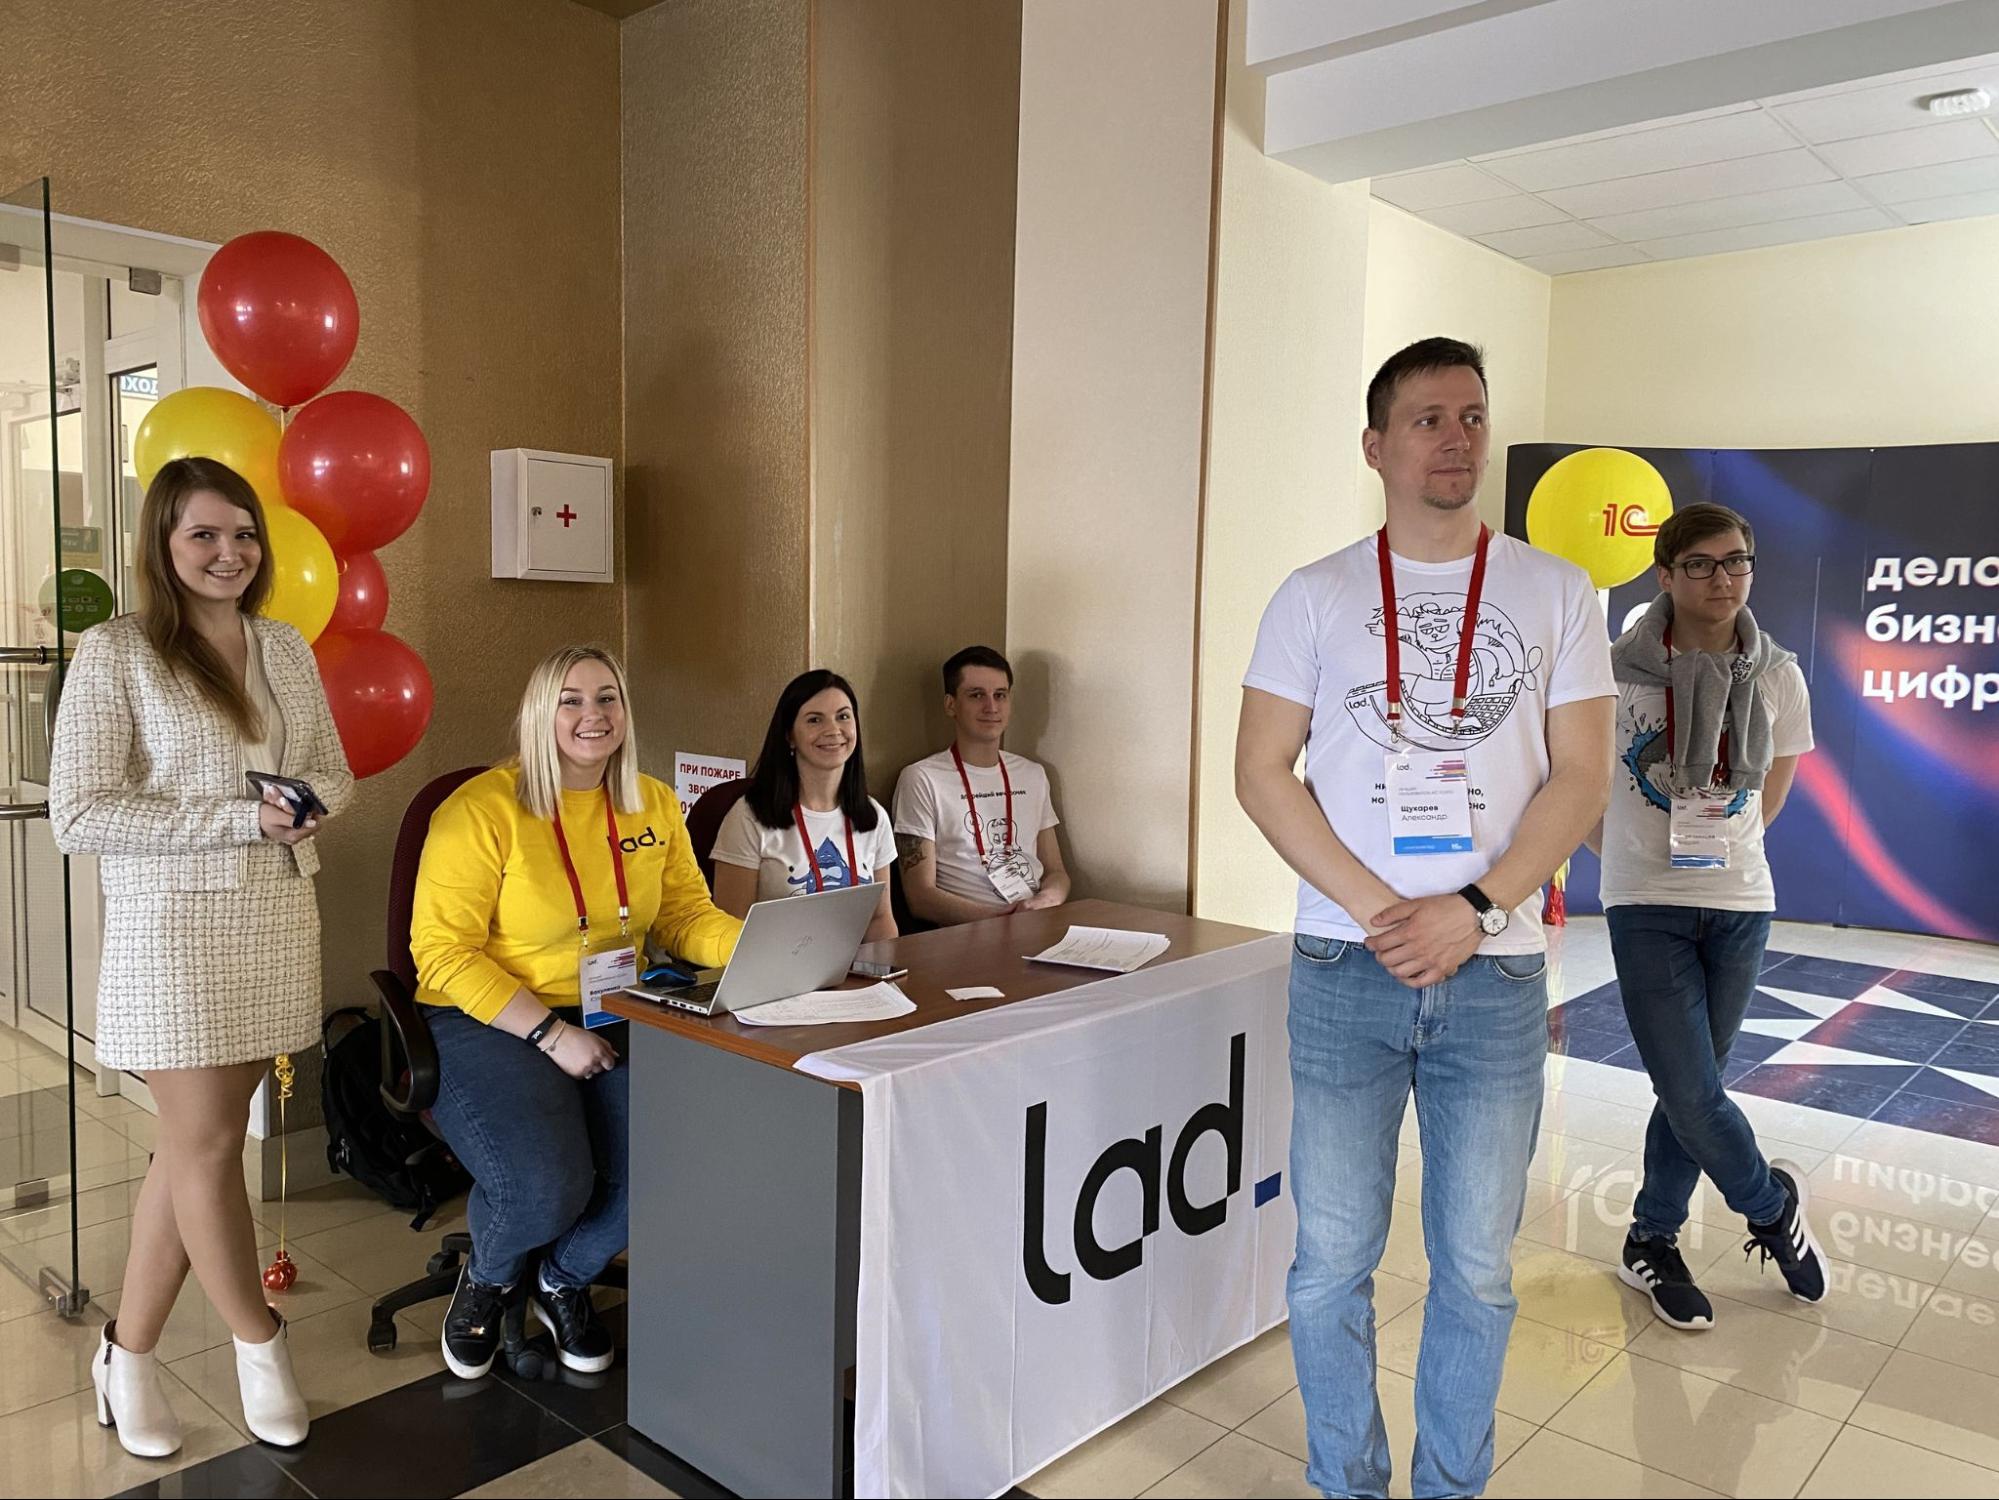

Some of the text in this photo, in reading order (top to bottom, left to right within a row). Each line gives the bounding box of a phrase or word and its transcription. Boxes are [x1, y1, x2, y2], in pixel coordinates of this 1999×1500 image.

[1865, 603, 1999, 644] бизн
[680, 763, 741, 779] ПРИ ПОЖАРЕ
[688, 783, 709, 794] ЗВО
[1401, 805, 1438, 813] Щукарев
[1402, 814, 1448, 822] Александр
[607, 826, 665, 854] ad.
[1023, 1031, 1282, 1305] lad.
